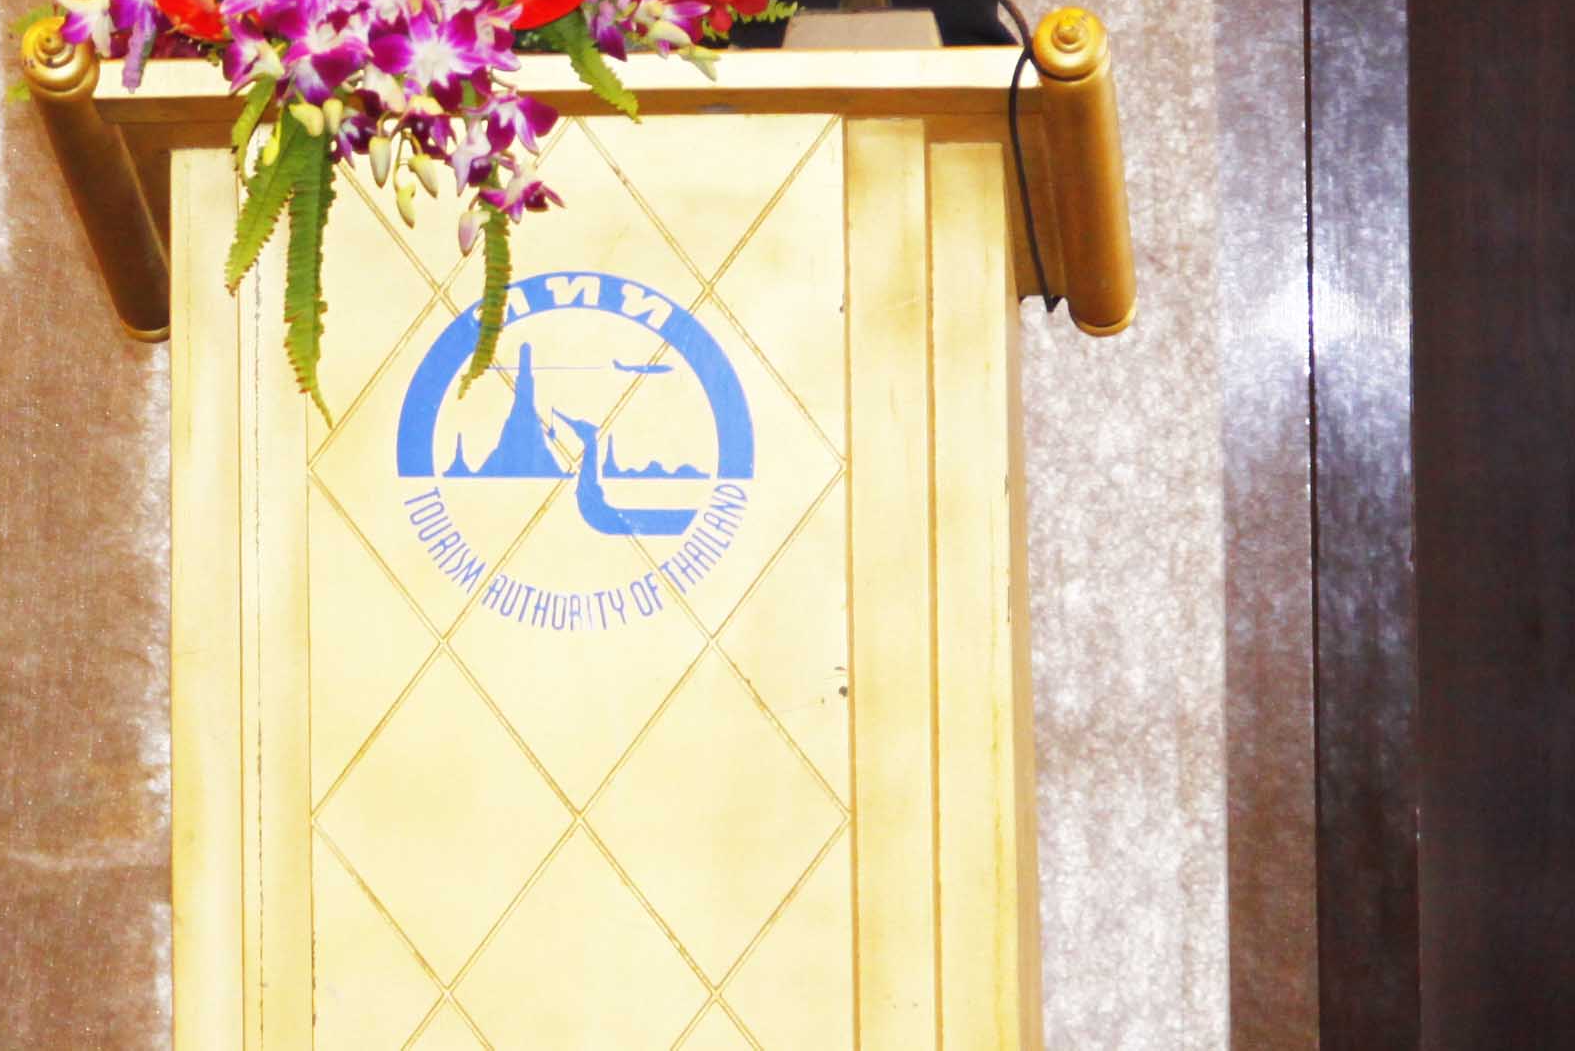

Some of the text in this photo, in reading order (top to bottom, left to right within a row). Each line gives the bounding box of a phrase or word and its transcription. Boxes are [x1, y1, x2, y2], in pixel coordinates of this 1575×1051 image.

[404, 482, 749, 632] TOURISM AUTHORITY OF THAILAND
